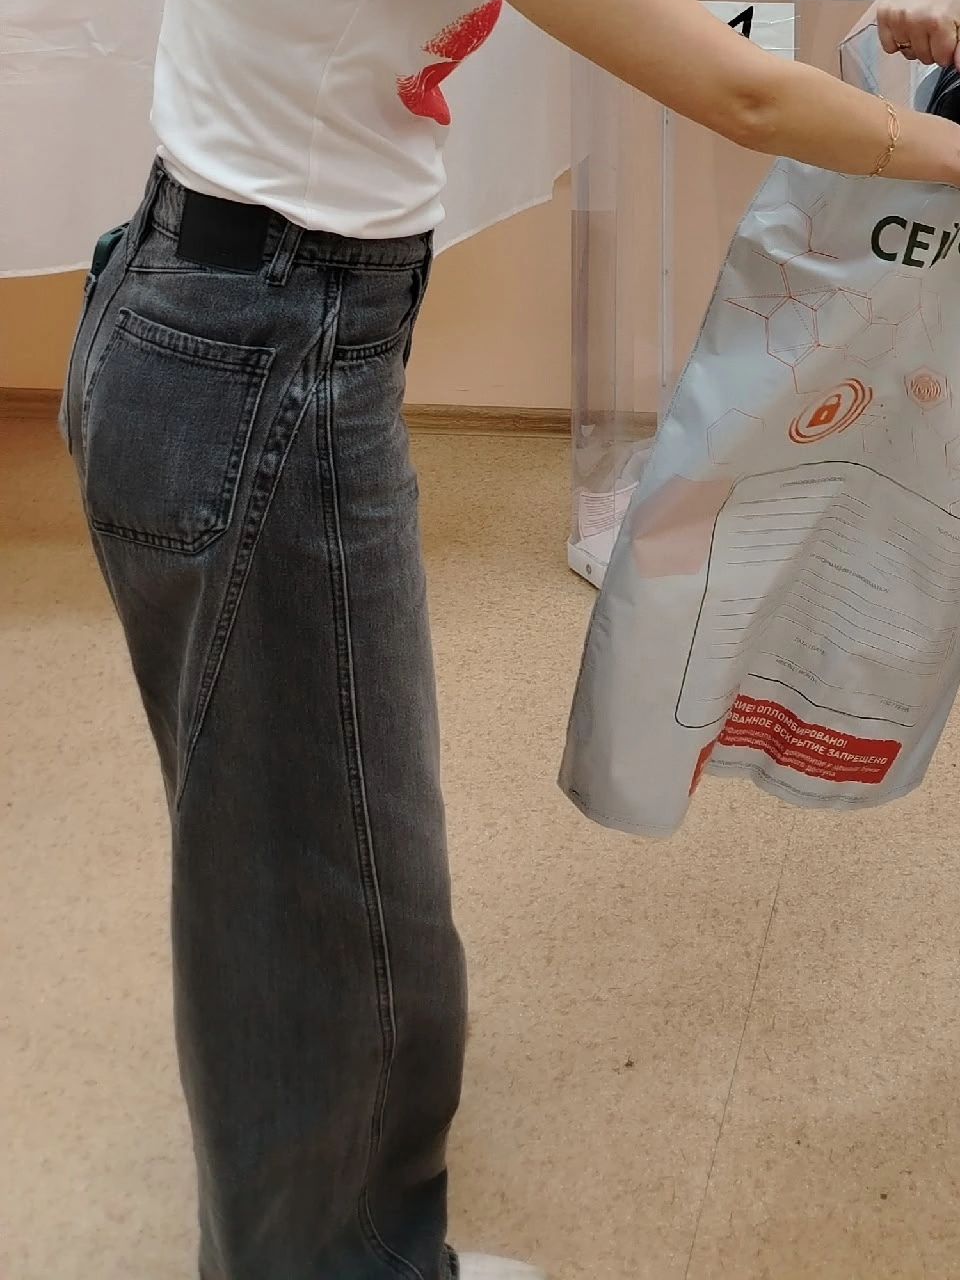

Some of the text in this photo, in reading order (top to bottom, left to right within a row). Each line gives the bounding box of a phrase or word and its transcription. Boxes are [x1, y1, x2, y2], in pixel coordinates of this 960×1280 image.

[756, 705, 848, 749] ОПЛОМБИРОВАНО!
[773, 723, 827, 755] ВСКРЫТИЕ
[827, 748, 889, 765] ЗАПРЕЩЕНО
